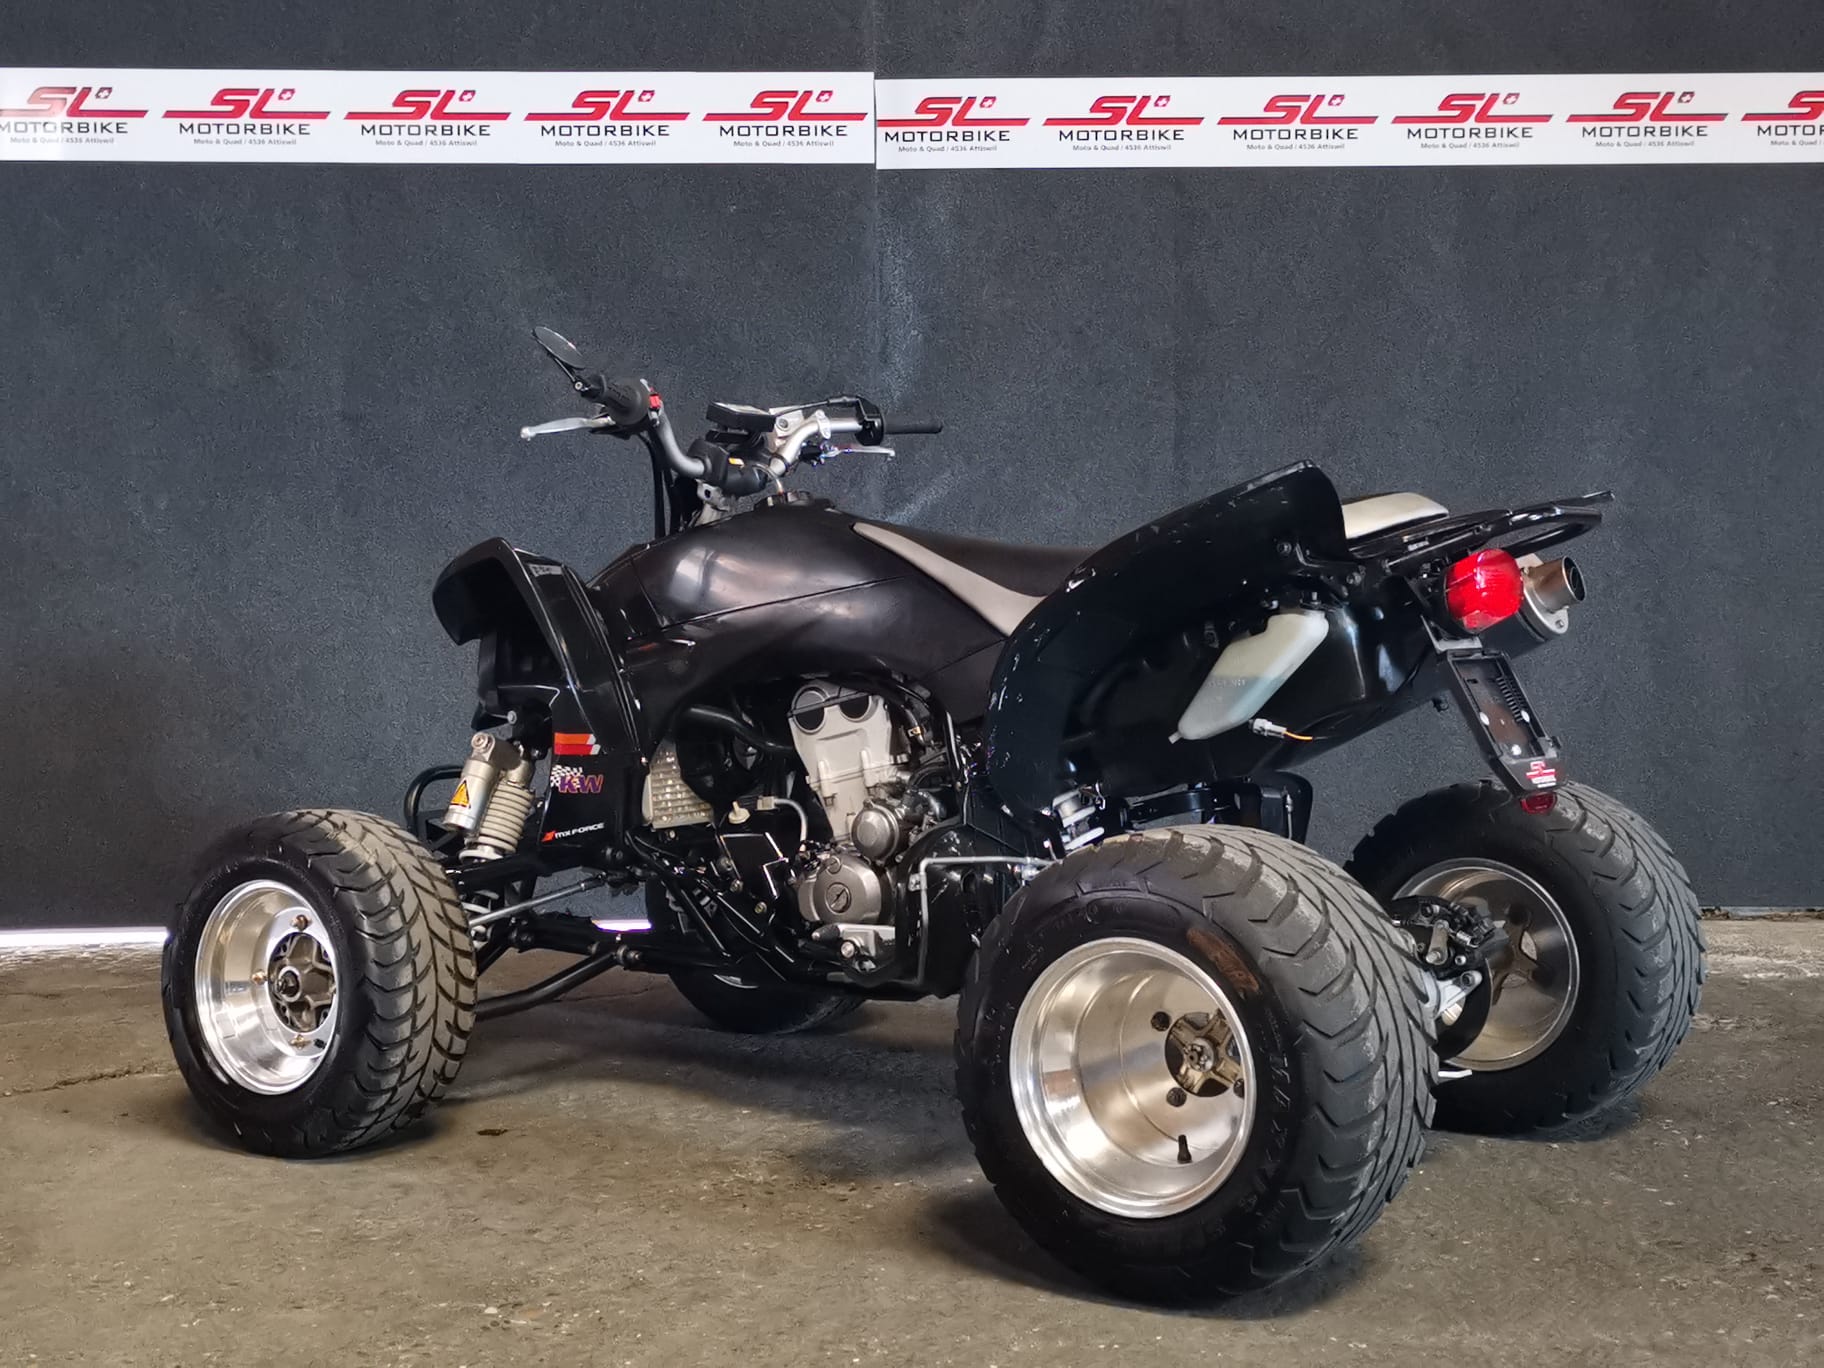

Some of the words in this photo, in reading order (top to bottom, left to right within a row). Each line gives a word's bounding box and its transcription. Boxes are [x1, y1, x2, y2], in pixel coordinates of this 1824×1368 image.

[0, 122, 128, 133] MOTORBIKE
[179, 123, 310, 135] MOTORBIKE
[361, 124, 490, 136] MOTORBIKE
[541, 125, 670, 136] MOTORBIKE
[720, 125, 847, 136] MOTORBIKE
[1408, 127, 1533, 139] MOTORBIKE
[1582, 126, 1708, 138] MOTORBIKE
[885, 130, 1010, 142] MOTORBIKE
[1059, 130, 1184, 141] MOTORBIKE
[1233, 128, 1358, 140] MOTORBIKE
[572, 822, 604, 834] FORCE
